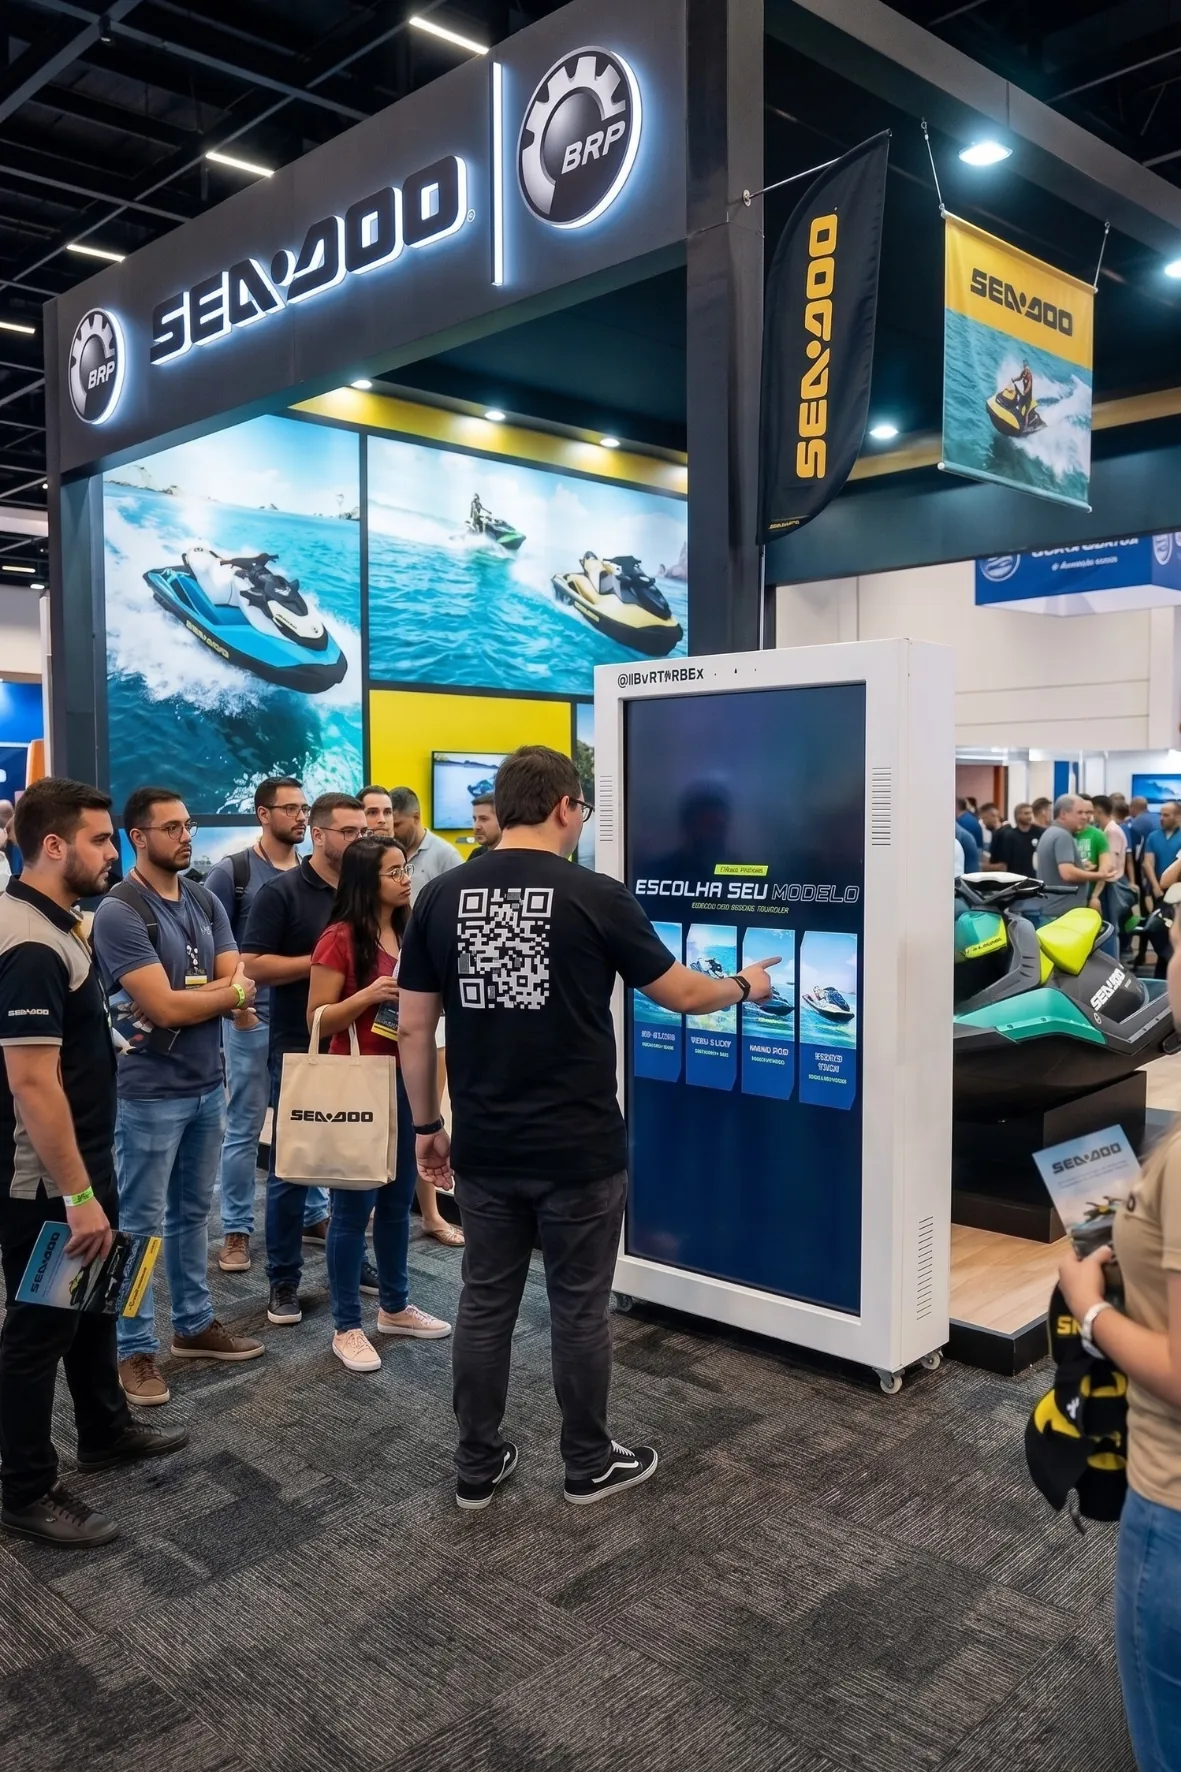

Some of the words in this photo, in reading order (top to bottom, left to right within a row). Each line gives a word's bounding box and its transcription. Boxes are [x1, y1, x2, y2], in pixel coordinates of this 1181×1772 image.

[561, 120, 626, 175] BRP
[87, 360, 116, 389] BRP
[635, 879, 723, 898] ESCOLHA
[727, 882, 769, 900] SEU
[771, 883, 860, 903] MODELO
